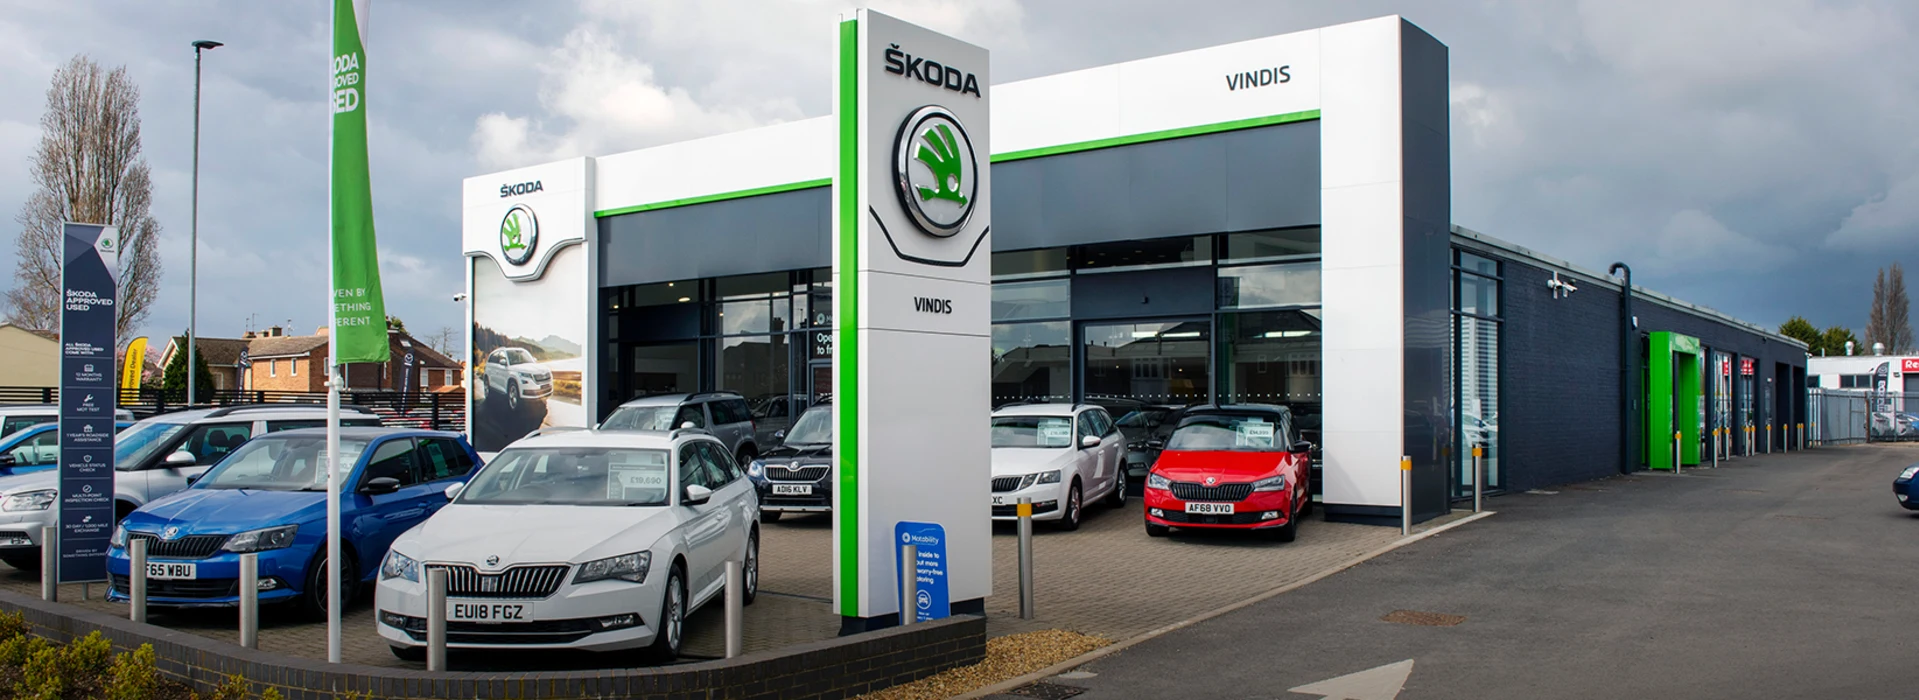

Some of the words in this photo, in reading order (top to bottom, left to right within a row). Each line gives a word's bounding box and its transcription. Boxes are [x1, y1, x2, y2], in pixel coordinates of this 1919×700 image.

[884, 43, 981, 98] ŠKODA
[1225, 65, 1291, 91] VINDIS
[500, 180, 544, 198] ŠKODA
[66, 289, 97, 297] ŠKODA
[356, 287, 366, 297] BY
[66, 298, 113, 306] APPROVED
[913, 296, 952, 314] VINDIS
[816, 345, 825, 355] to
[1189, 503, 1211, 512] AF68
[911, 535, 939, 545] Motability
[168, 564, 191, 577] WBU
[455, 604, 488, 619] EU18
[492, 605, 523, 620] FGZ
